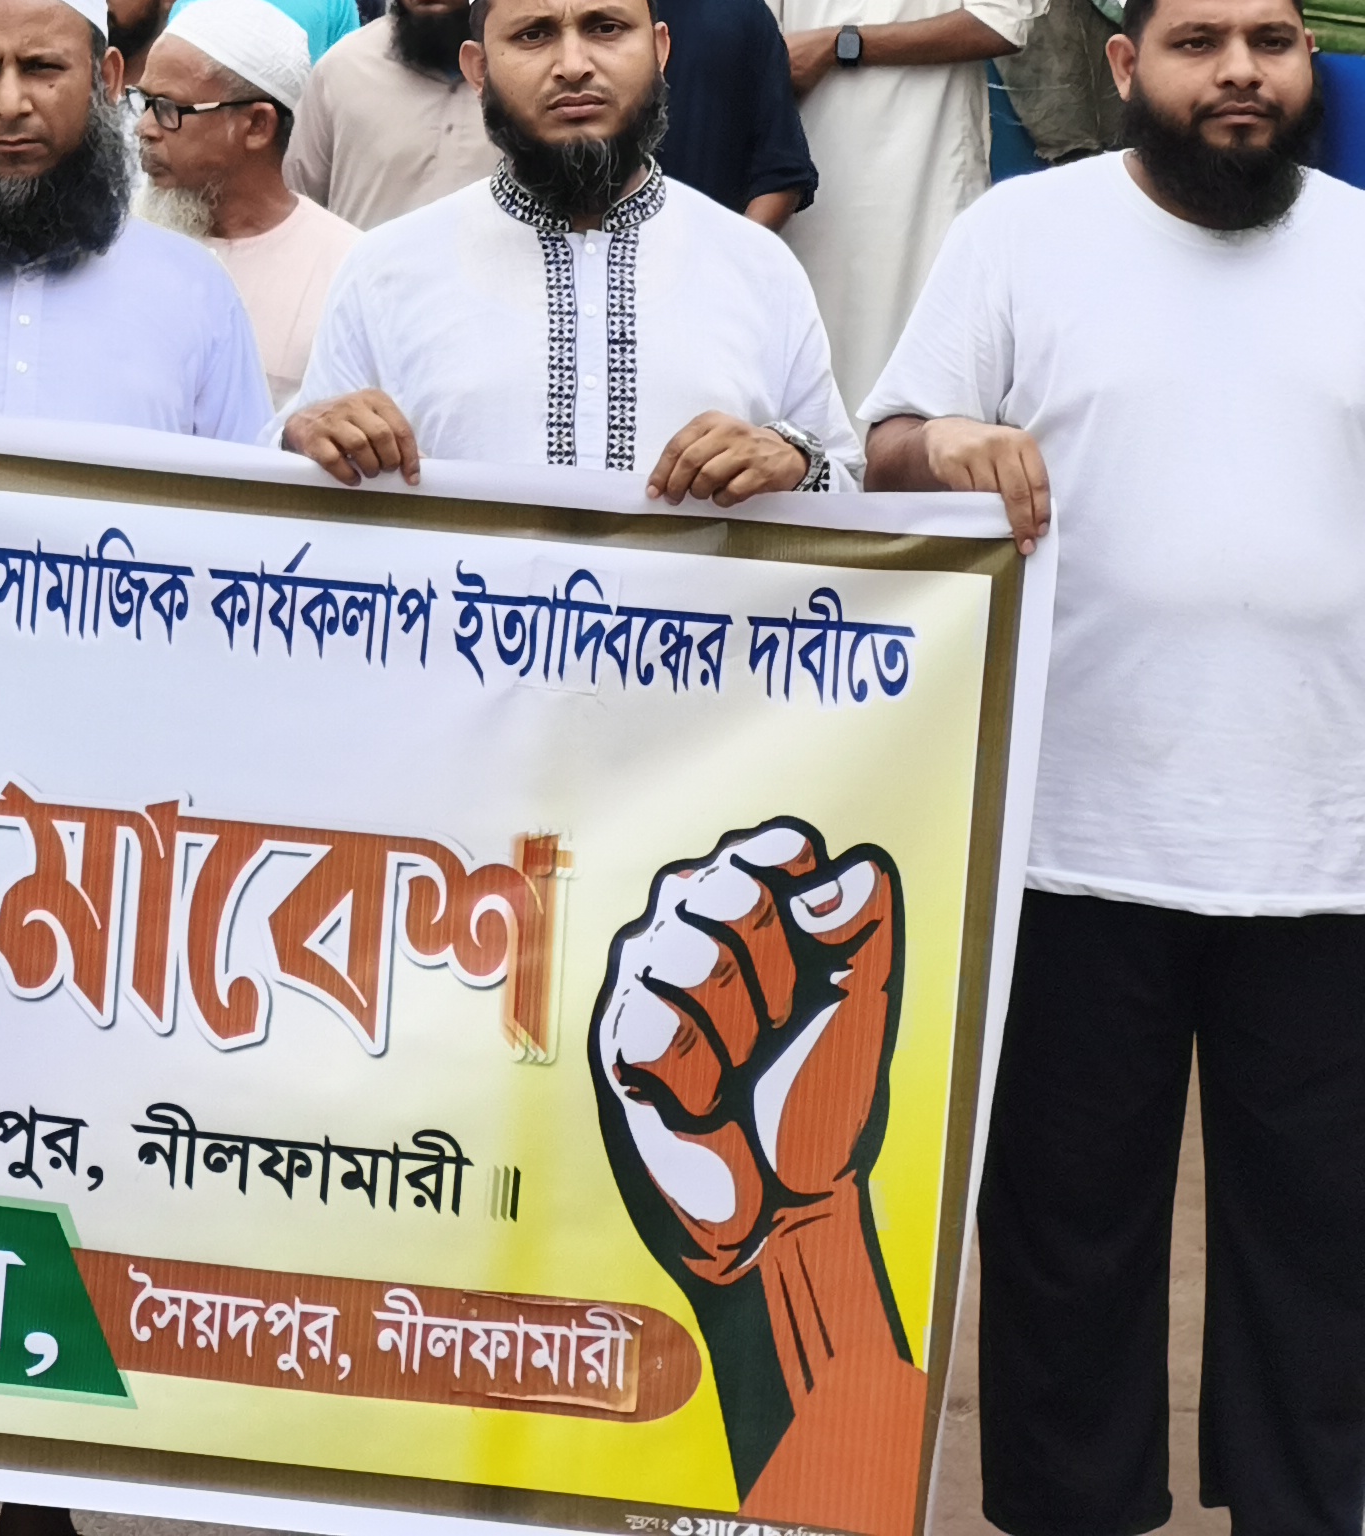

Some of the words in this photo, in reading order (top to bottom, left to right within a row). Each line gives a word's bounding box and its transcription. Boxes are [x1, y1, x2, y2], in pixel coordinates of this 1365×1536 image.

[209, 543, 437, 667] কার্যকলাপ
[452, 561, 733, 692] ইত্যাদিবন্ধের
[747, 587, 914, 702] দাবীতে
[132, 1103, 473, 1216] নীলফামারী
[122, 1258, 359, 1387] সৈয়দপুর,
[374, 1288, 632, 1390] নীলফামারী
